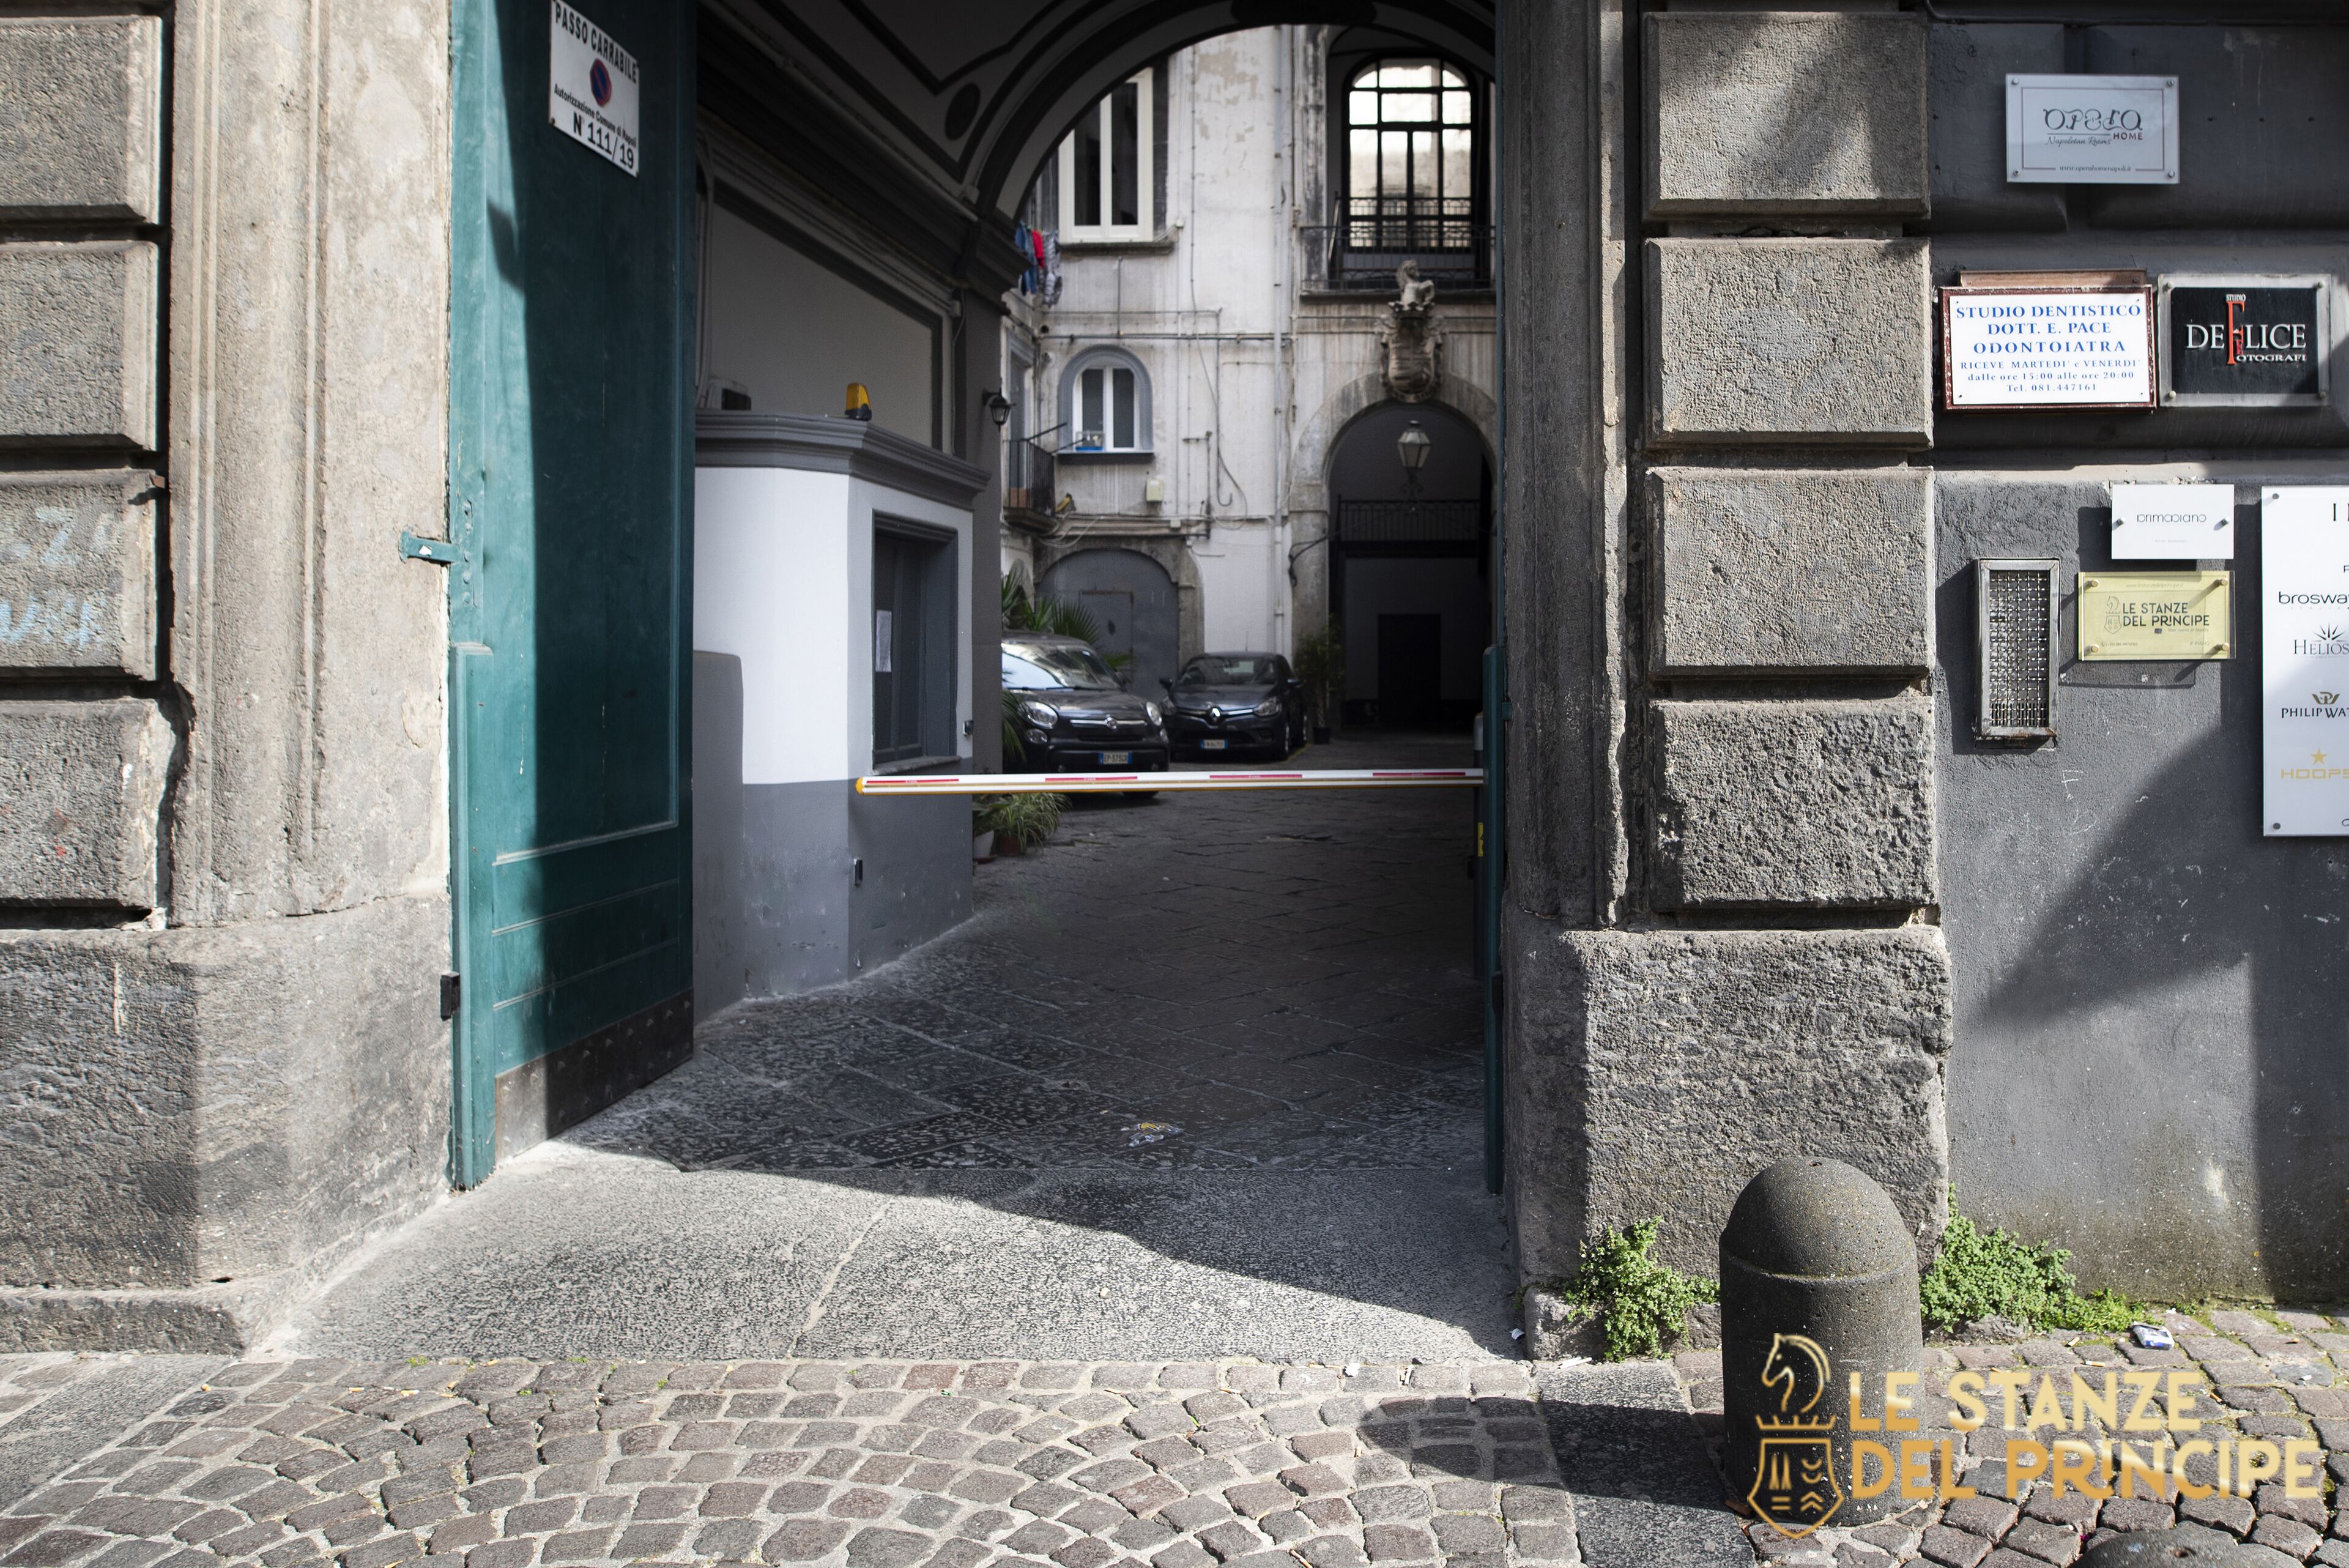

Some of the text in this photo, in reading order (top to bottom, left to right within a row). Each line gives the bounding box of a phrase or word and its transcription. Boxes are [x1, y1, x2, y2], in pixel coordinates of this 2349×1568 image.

[555, 2, 637, 84] PASSO CARRABILE
[554, 83, 595, 118] Autorizzazione
[596, 111, 615, 133] Comune
[623, 130, 637, 147] Napoli
[2046, 136, 2112, 147] Napoletan Rooms
[1957, 305, 2140, 319] STUDIO DENTISTICO
[1988, 322, 2112, 335] DOTT. E. PACE
[1973, 340, 2126, 354] ODONTOIATRA
[1961, 361, 2004, 370] RICEVE
[2011, 360, 2071, 368] MARTEDI'
[1967, 373, 1996, 381] dalle
[2031, 384, 2097, 392] 081.447161
[2123, 602, 2188, 614] LE STANZE
[2123, 615, 2210, 626] DEL PRINCIPE
[2281, 708, 2322, 718] PHILIP
